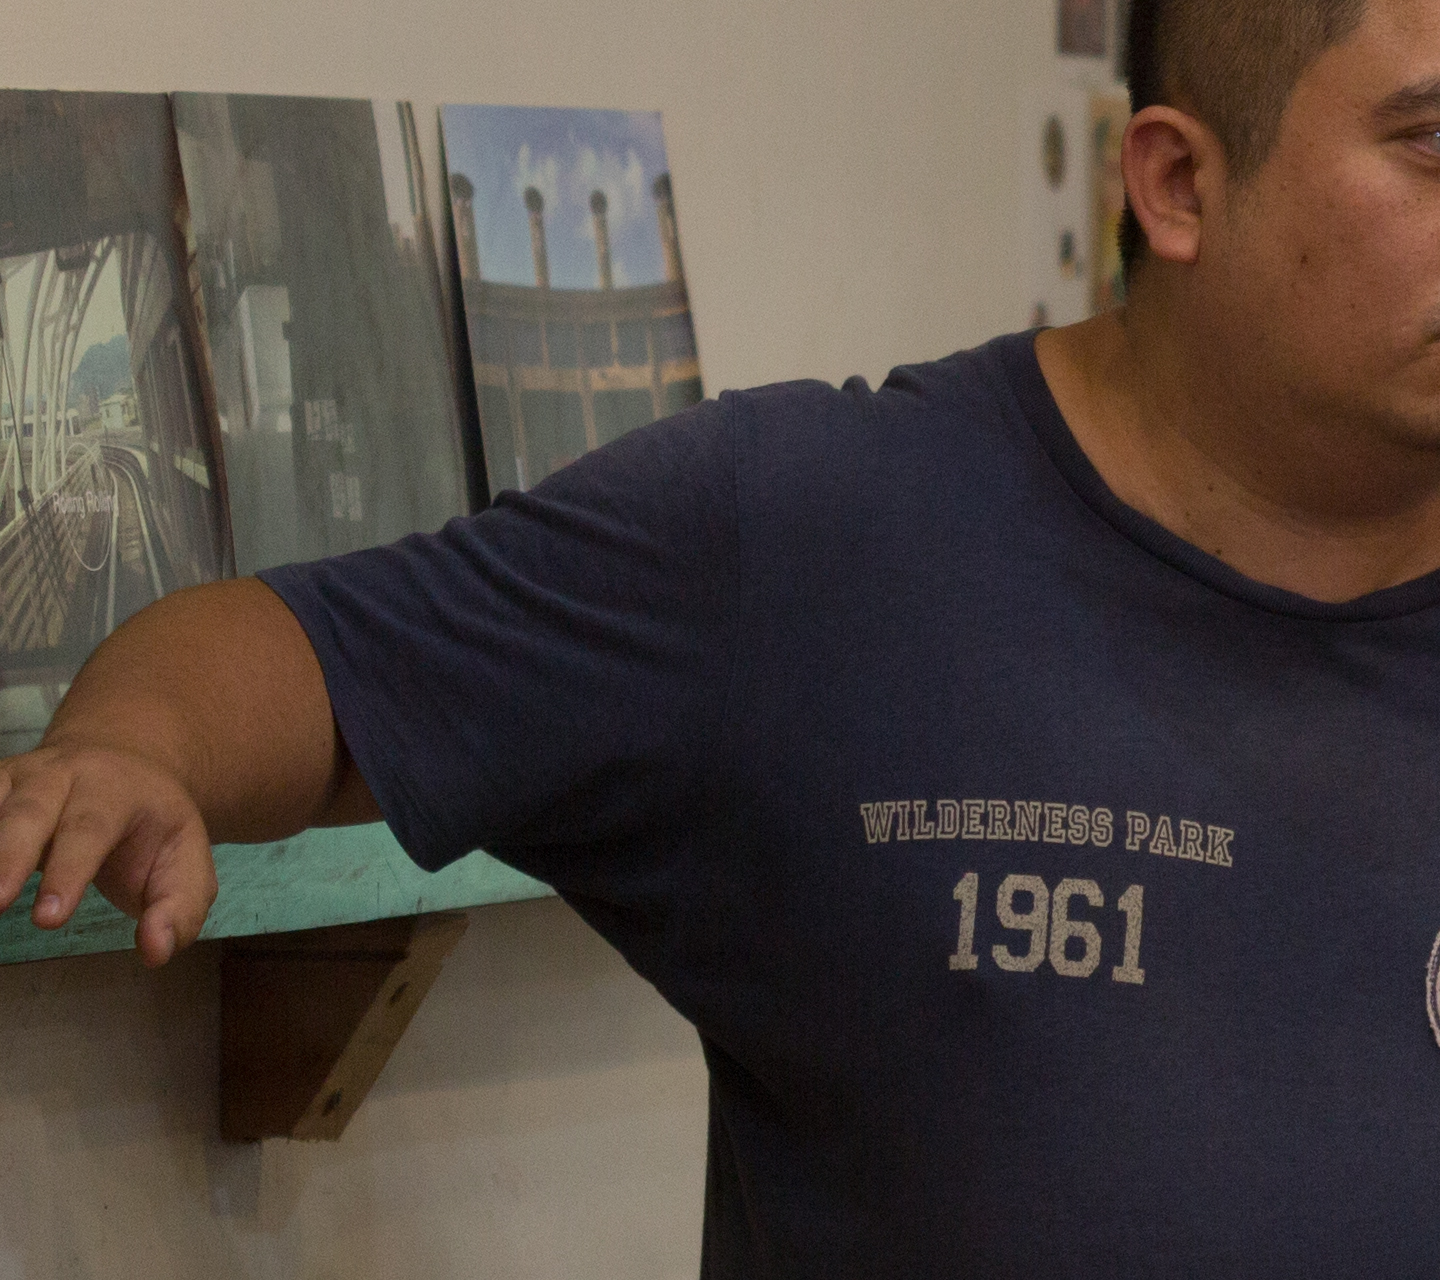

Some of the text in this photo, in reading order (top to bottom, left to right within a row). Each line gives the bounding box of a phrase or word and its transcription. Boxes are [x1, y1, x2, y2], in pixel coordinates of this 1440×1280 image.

[860, 799, 1235, 867] WILDERNESS PARK
[948, 872, 1146, 985] 1961
